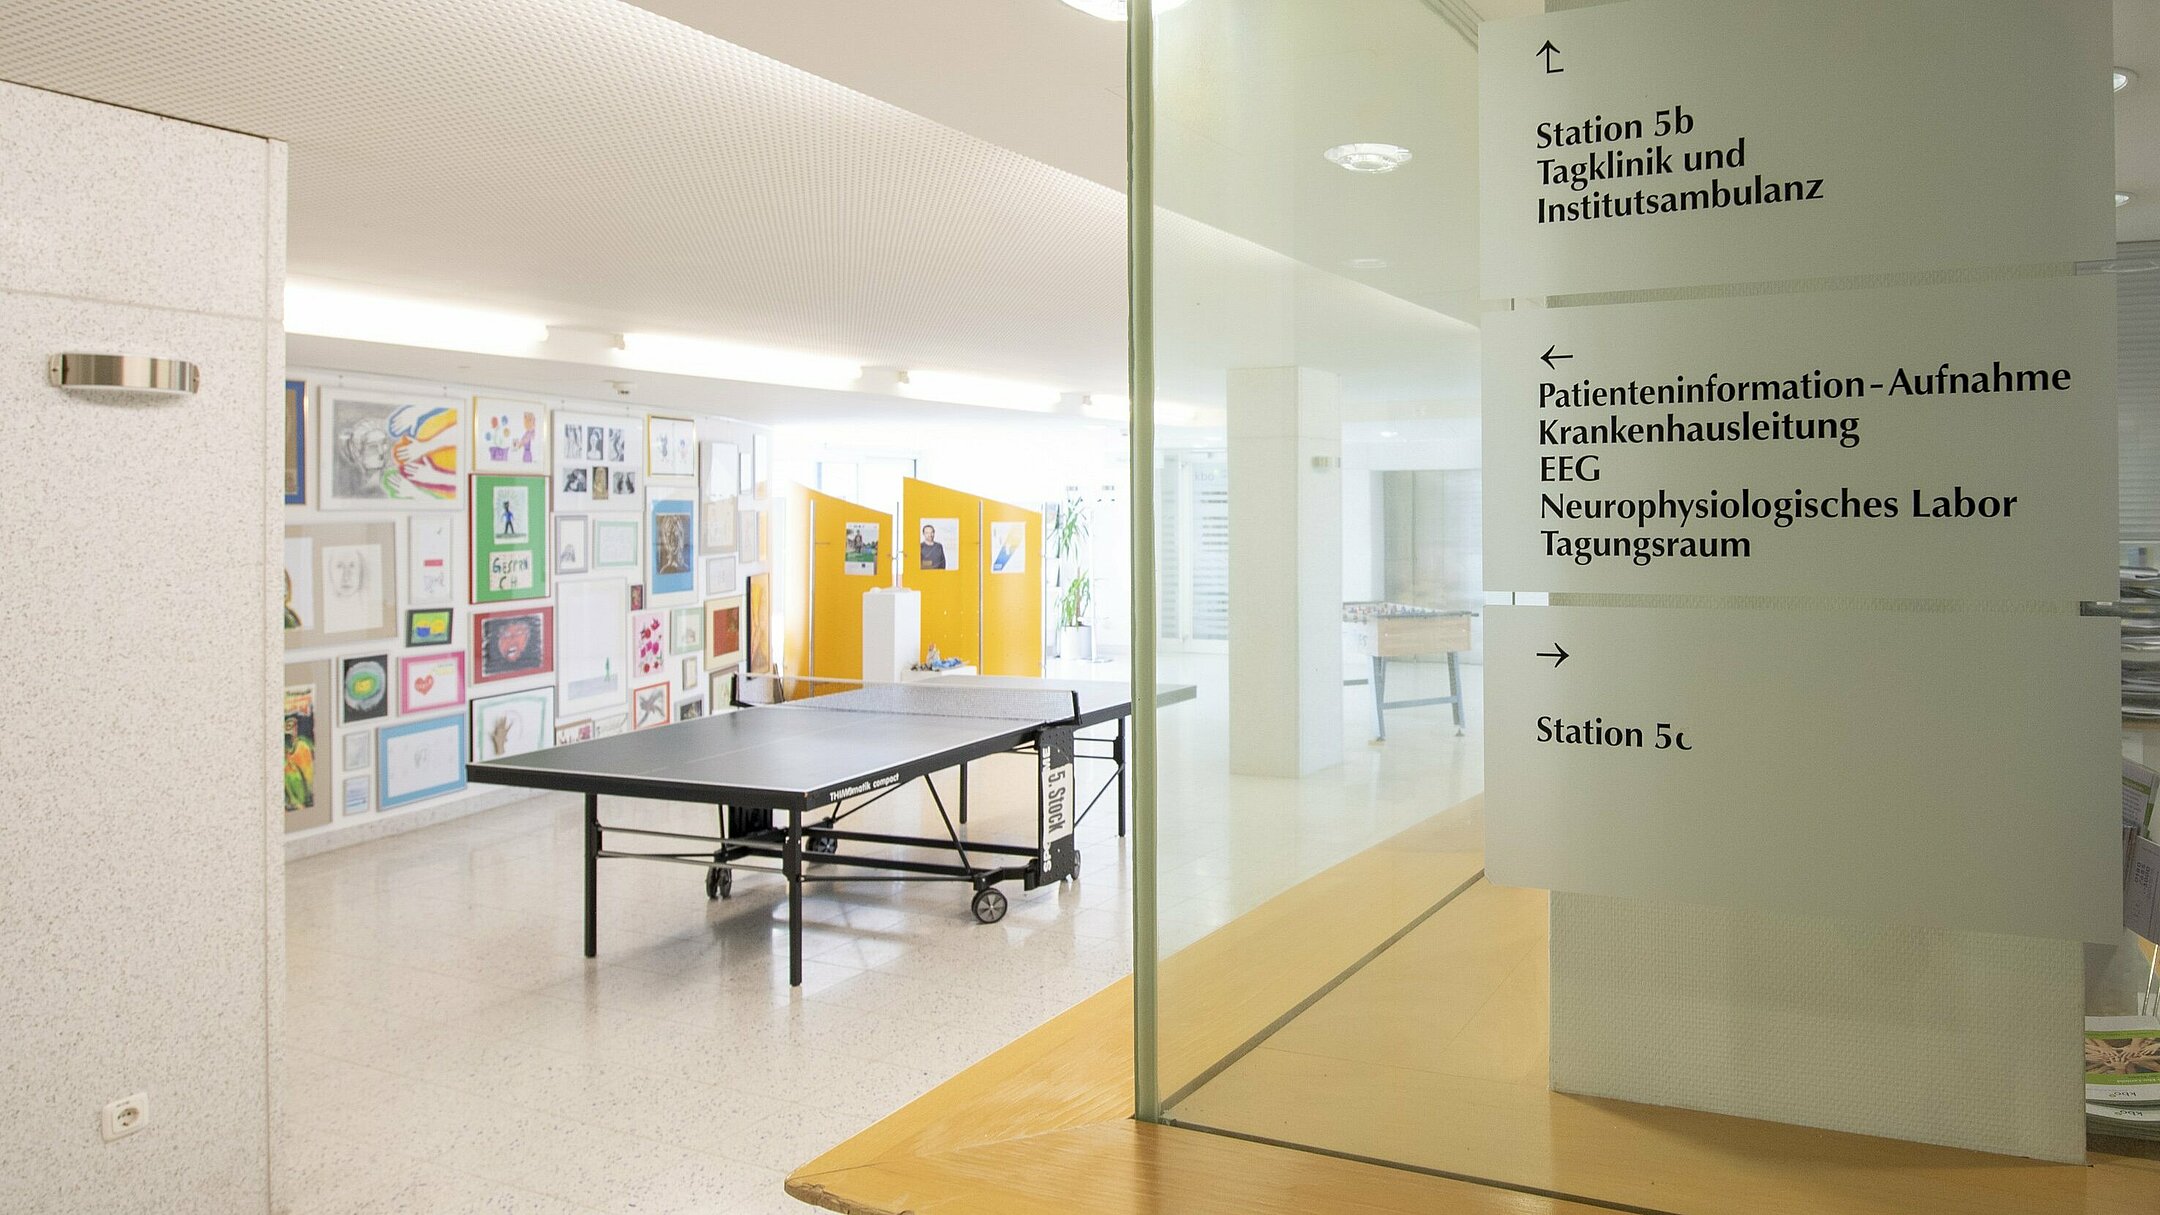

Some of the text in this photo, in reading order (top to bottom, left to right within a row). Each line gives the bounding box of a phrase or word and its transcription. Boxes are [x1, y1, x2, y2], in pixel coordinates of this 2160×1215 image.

[1536, 105, 1694, 149] Station 5b
[1536, 136, 1745, 192] Tagklinik und
[1537, 174, 1824, 224] Institutsambulanz
[1539, 410, 1860, 449] Krankenhausleitung
[1541, 454, 1600, 482] EEG
[1541, 486, 2018, 528] Neurophysiologisches Labor
[1540, 530, 1751, 567] Tagungsraum
[1537, 716, 1643, 748] Station
[1048, 770, 1066, 833] 5. Stock
